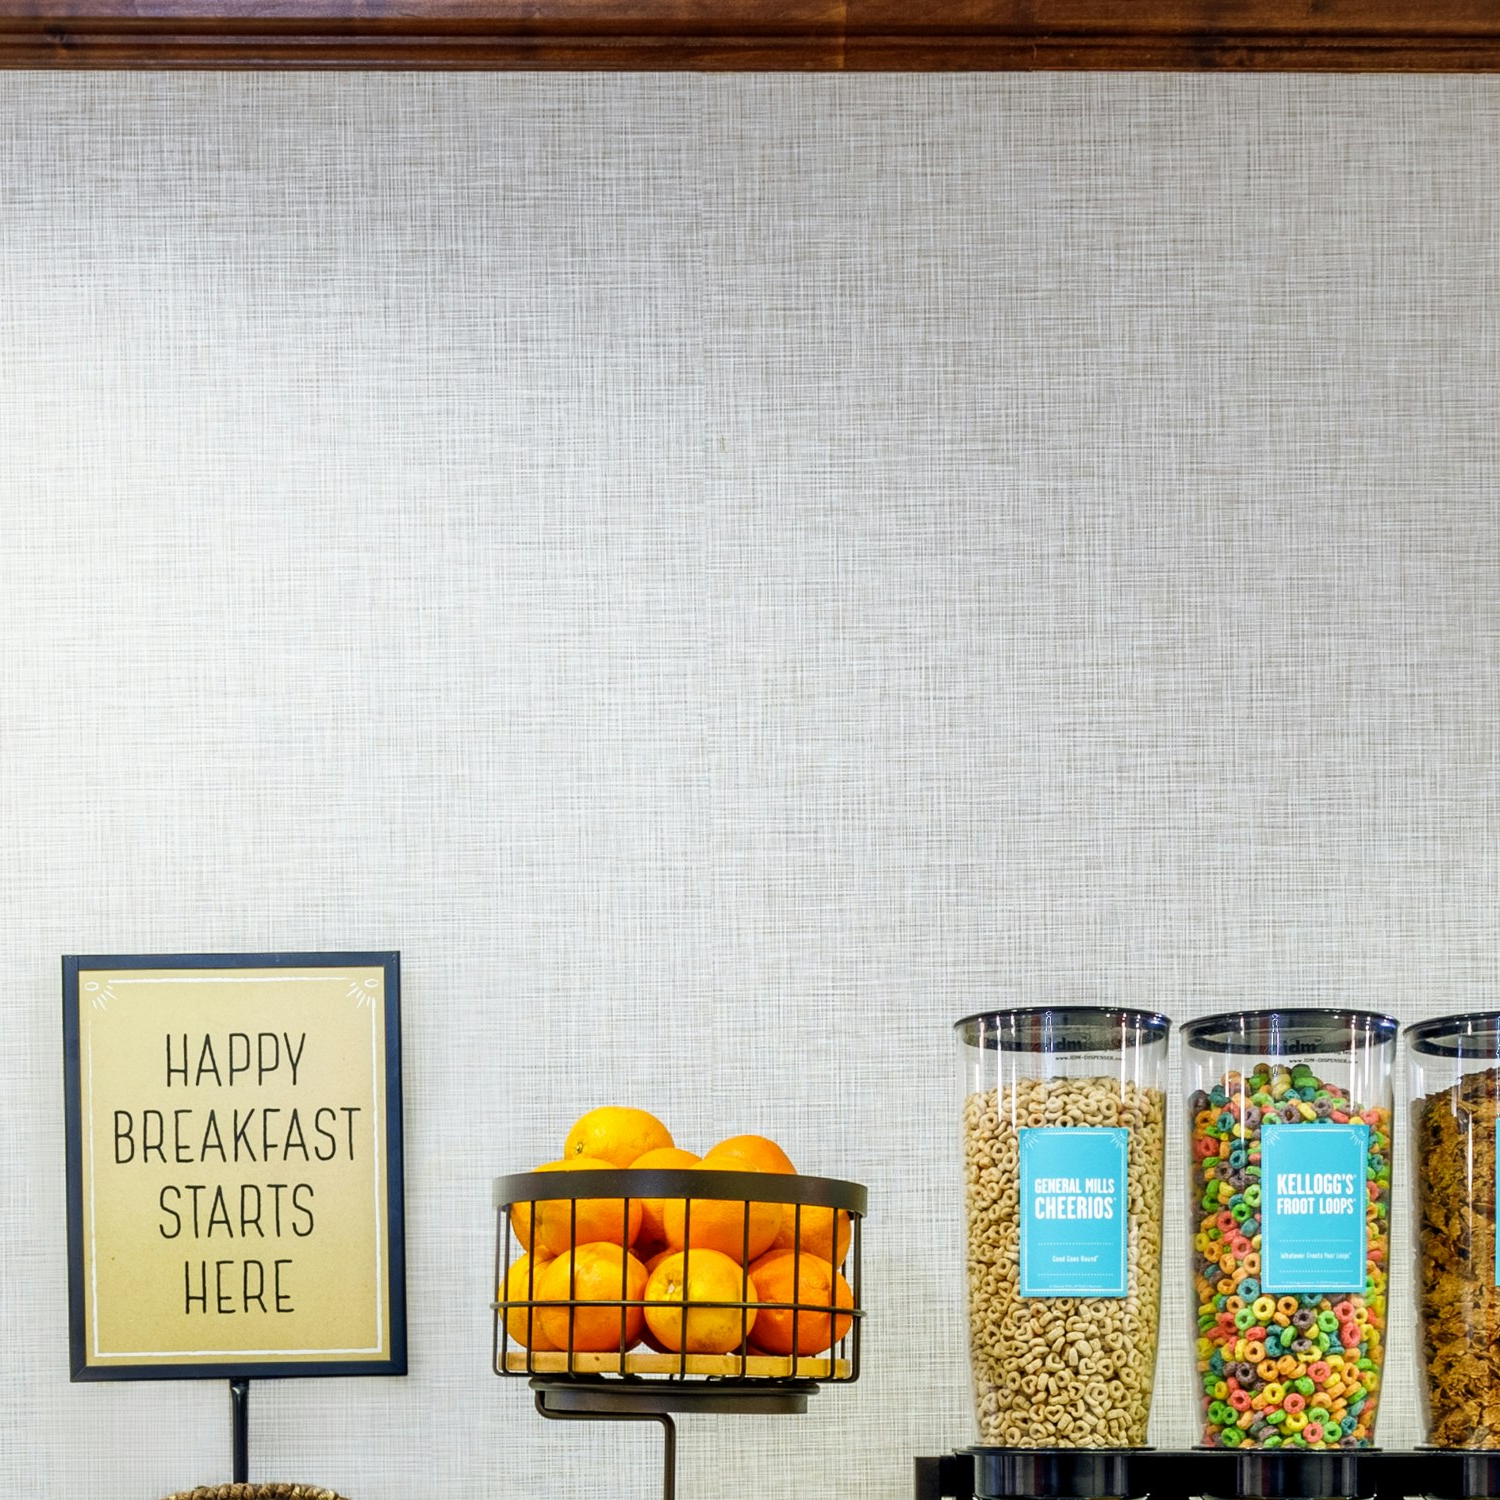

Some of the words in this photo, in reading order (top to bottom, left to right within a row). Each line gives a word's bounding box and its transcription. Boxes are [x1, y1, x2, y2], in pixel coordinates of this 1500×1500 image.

[166, 1032, 306, 1087] HAPPY
[114, 1107, 362, 1164] BREAKFAST
[1034, 1177, 1081, 1194] GENERAL
[1085, 1177, 1115, 1194] MILLS
[1277, 1173, 1355, 1195] KELLOGG'S
[159, 1183, 315, 1239] STARTS
[1034, 1196, 1114, 1220] CHEERIOS
[1277, 1197, 1315, 1215] FROOT
[1319, 1197, 1354, 1214] LOOPS
[184, 1259, 295, 1315] HERE
